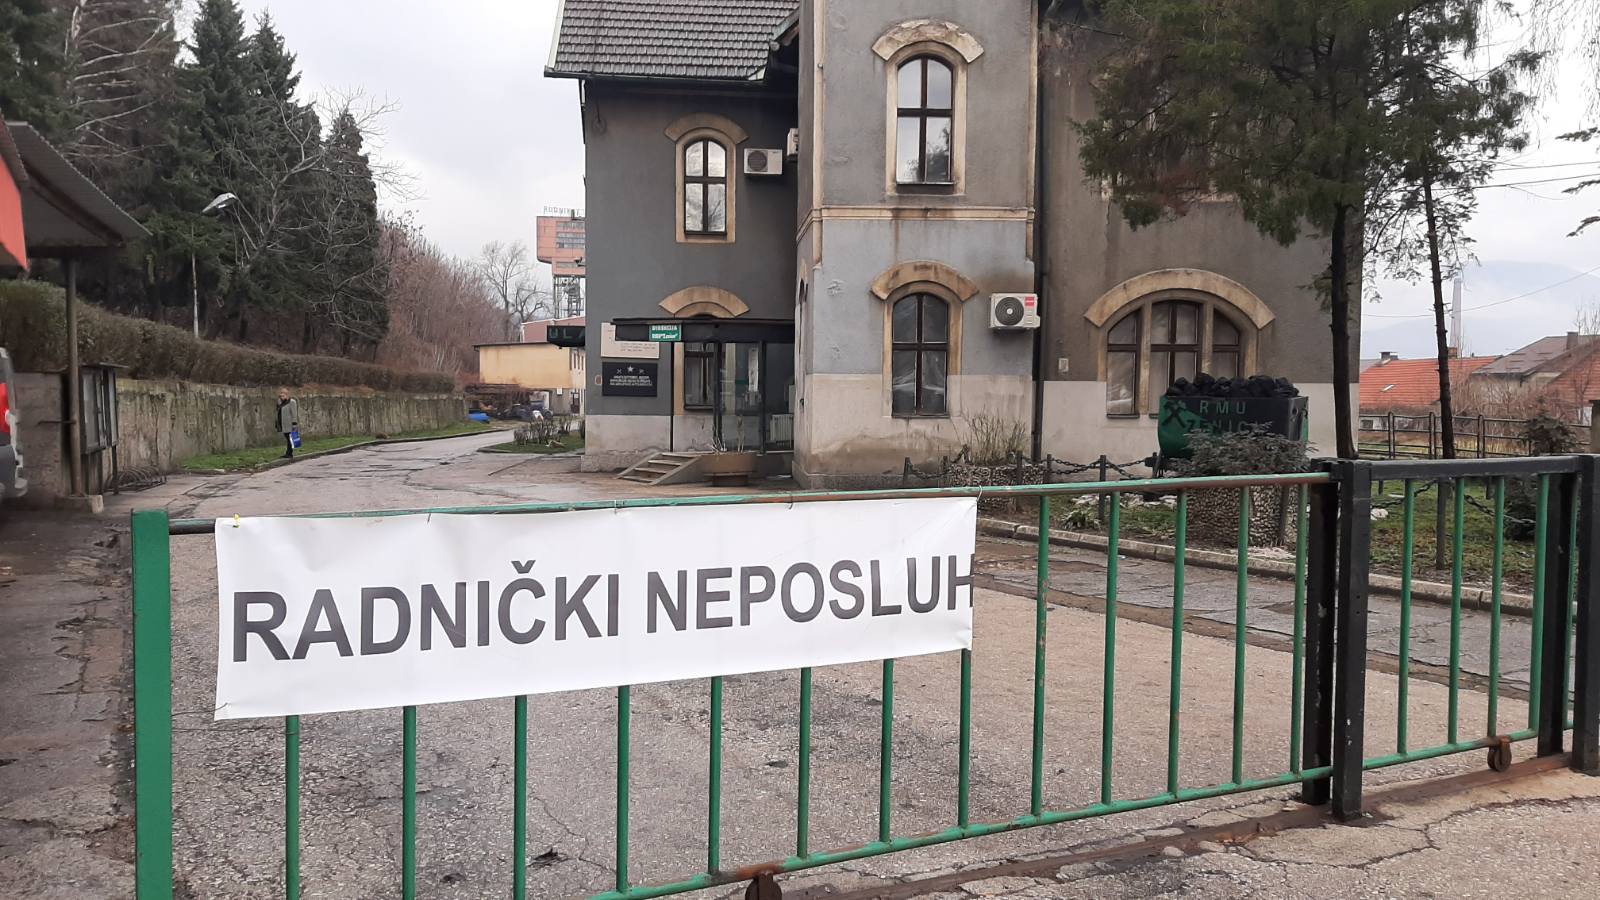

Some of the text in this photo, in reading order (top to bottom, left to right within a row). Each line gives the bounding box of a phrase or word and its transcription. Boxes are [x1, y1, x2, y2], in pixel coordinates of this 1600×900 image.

[1199, 400, 1246, 415] RMU
[232, 553, 975, 663] RADNIČKI NEPOSLUH
